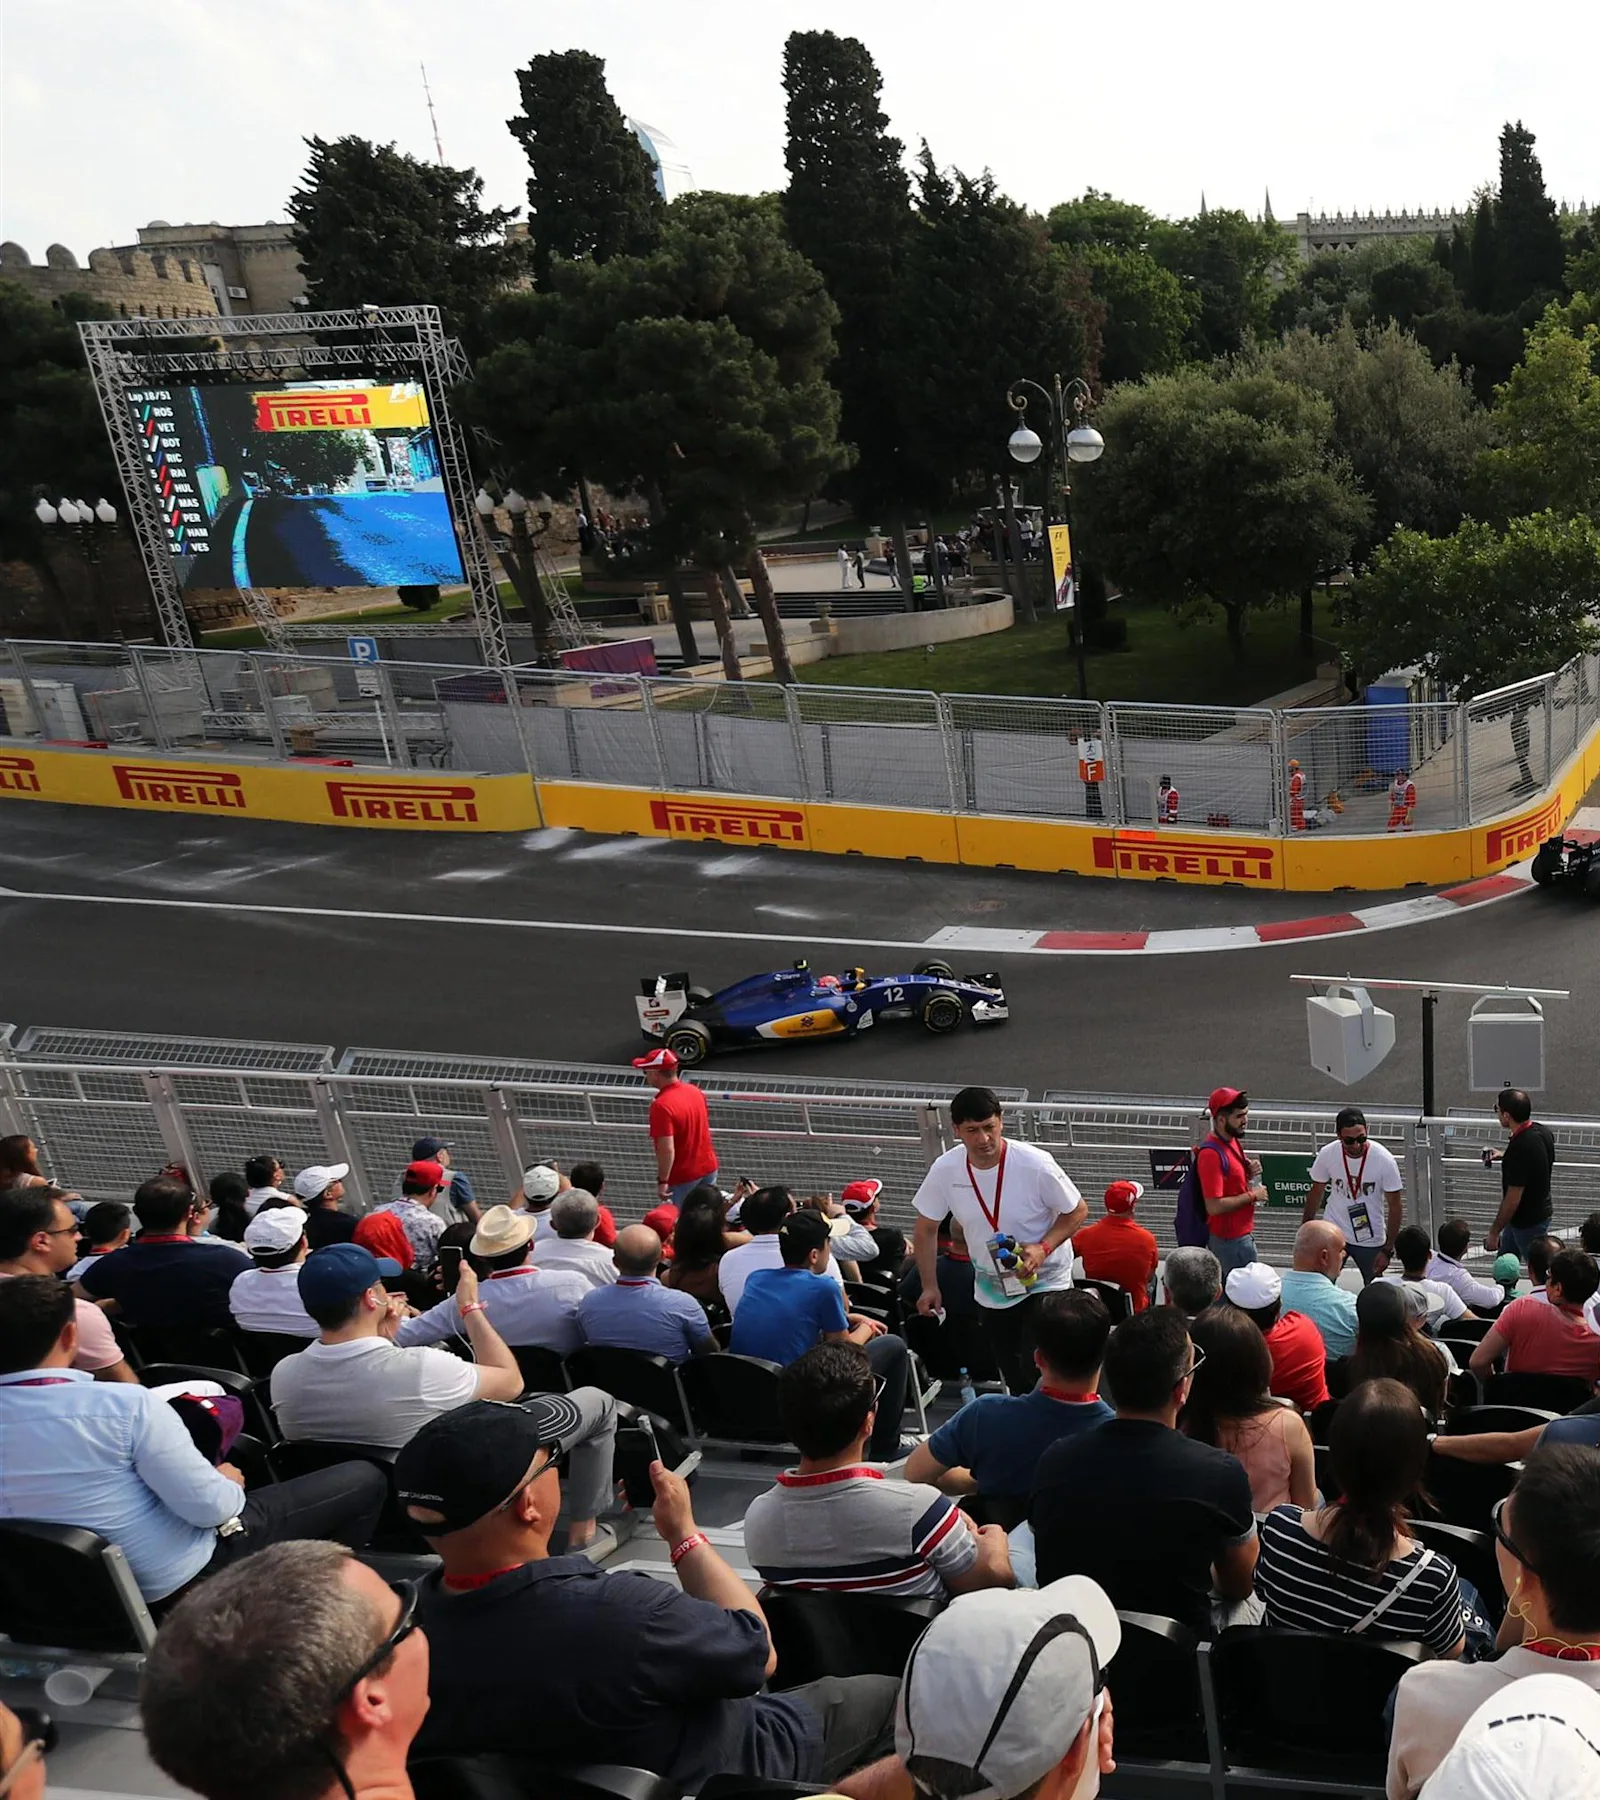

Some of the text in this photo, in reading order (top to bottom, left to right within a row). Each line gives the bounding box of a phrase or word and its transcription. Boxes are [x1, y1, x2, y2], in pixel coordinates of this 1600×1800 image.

[128, 391, 171, 403] Lap 18/51
[134, 408, 174, 418] 1 ROS
[256, 393, 371, 432] PIRELLI
[138, 423, 175, 433] 2 VET
[142, 438, 180, 448] 3 BOT
[147, 454, 183, 463] 4 RIC
[151, 469, 187, 478] 5 RAI
[154, 484, 194, 493] 6 HUL
[159, 498, 199, 508] 7 MAS
[163, 513, 201, 523] 8 PER
[167, 528, 208, 538] 9 HAM
[169, 543, 210, 552] 10 VES
[354, 643, 370, 661] P
[1088, 764, 1097, 781] F
[112, 765, 247, 808] PIRELLI
[325, 781, 478, 822] PIRELLI
[650, 801, 803, 841] PIRELLI
[1487, 793, 1561, 865] PIRELLI
[1092, 836, 1273, 880] PIRELLI
[883, 987, 905, 1002] 12
